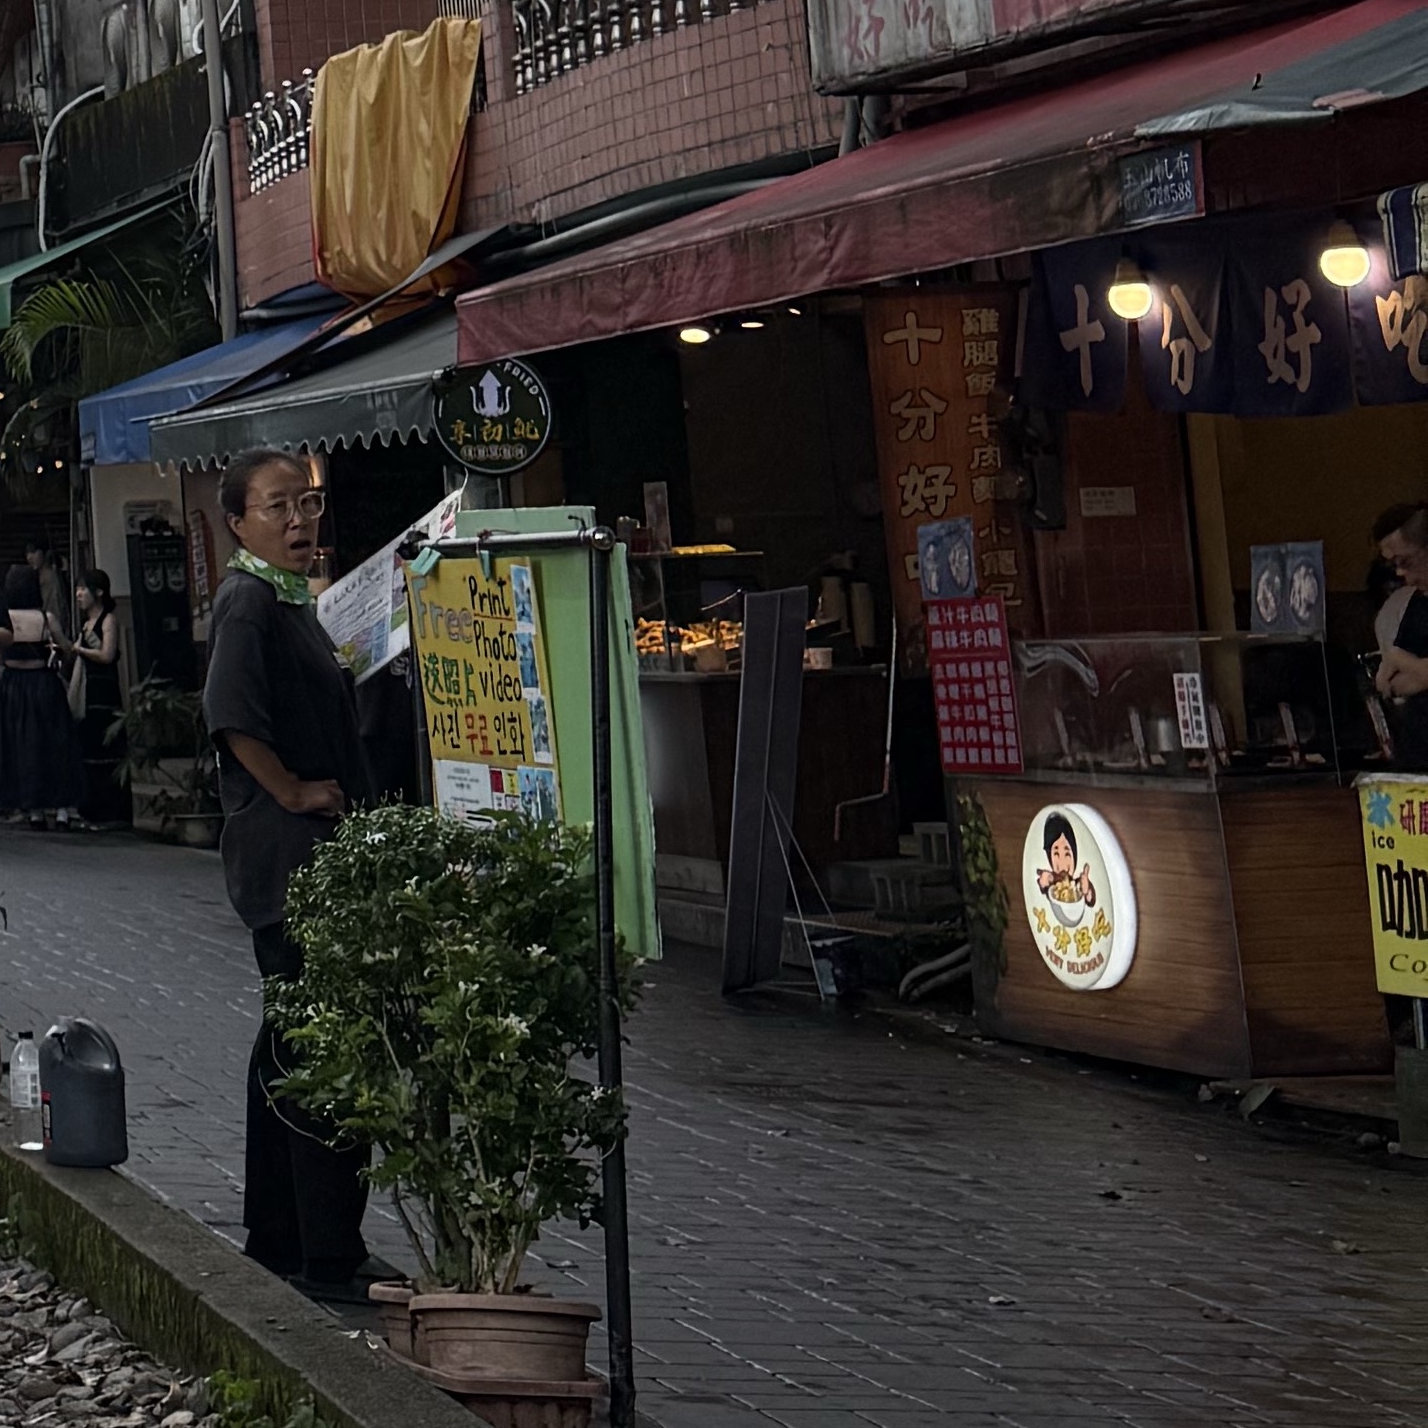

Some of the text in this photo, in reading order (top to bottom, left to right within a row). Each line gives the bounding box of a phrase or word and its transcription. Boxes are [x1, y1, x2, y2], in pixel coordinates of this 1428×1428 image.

[1059, 276, 1428, 397] 十分好吃
[410, 575, 474, 645] Free
[468, 575, 512, 617] Print
[472, 619, 518, 663] Photo
[478, 669, 523, 704] video
[431, 709, 527, 762] 사진 무료 인화
[1371, 829, 1396, 849] ice
[1389, 952, 1428, 981] Co
